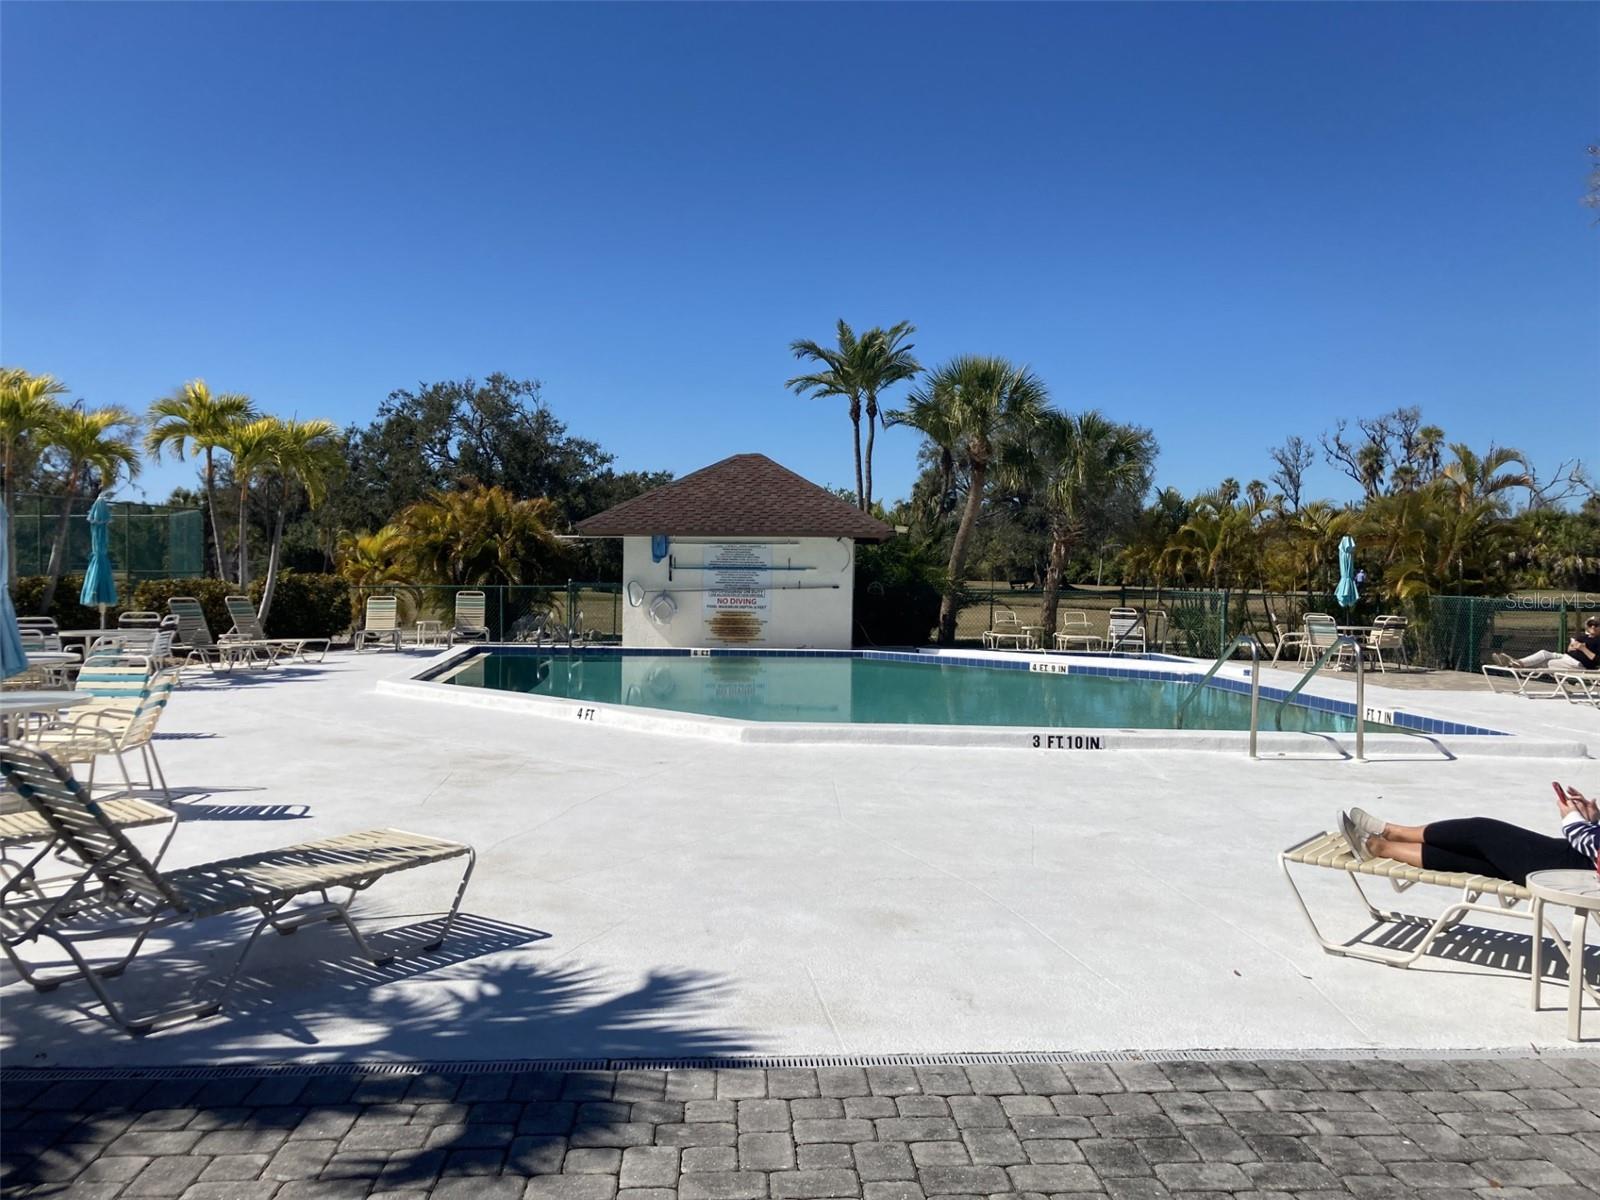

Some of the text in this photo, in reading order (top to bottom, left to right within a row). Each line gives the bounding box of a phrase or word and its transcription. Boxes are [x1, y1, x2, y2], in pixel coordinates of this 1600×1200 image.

[716, 597, 757, 605] NO DIVING
[576, 707, 583, 720] 4
[1377, 710, 1382, 722] 7
[1032, 734, 1041, 748] 3
[1066, 735, 1083, 749] 10
